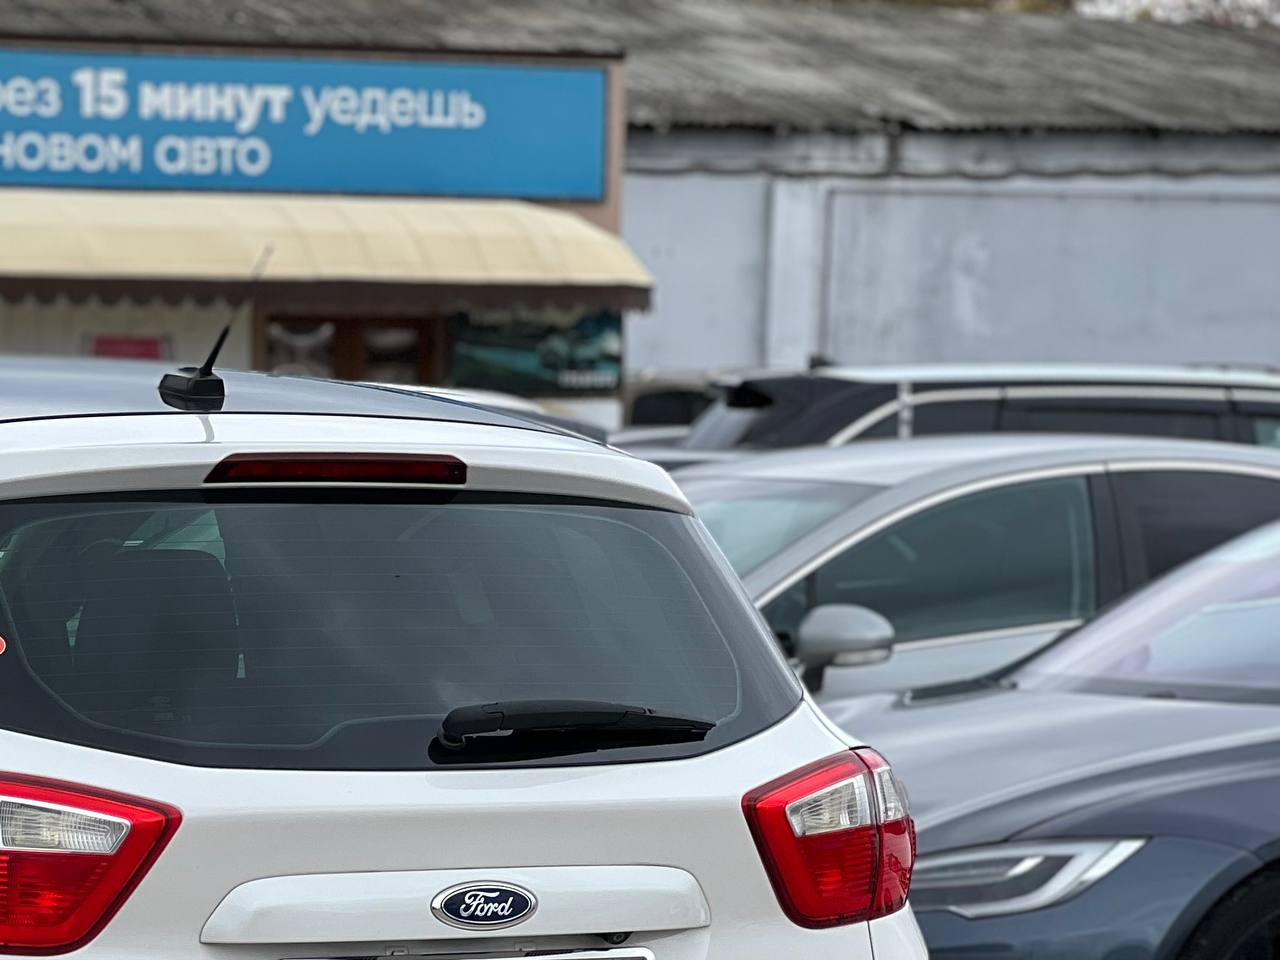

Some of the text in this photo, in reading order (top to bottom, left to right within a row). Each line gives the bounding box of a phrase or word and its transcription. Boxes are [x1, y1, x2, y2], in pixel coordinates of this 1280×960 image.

[72, 65, 131, 120] 15
[138, 80, 293, 134] минут
[301, 85, 487, 136] уедешь
[153, 134, 272, 177] авто
[460, 891, 514, 917] Ford
